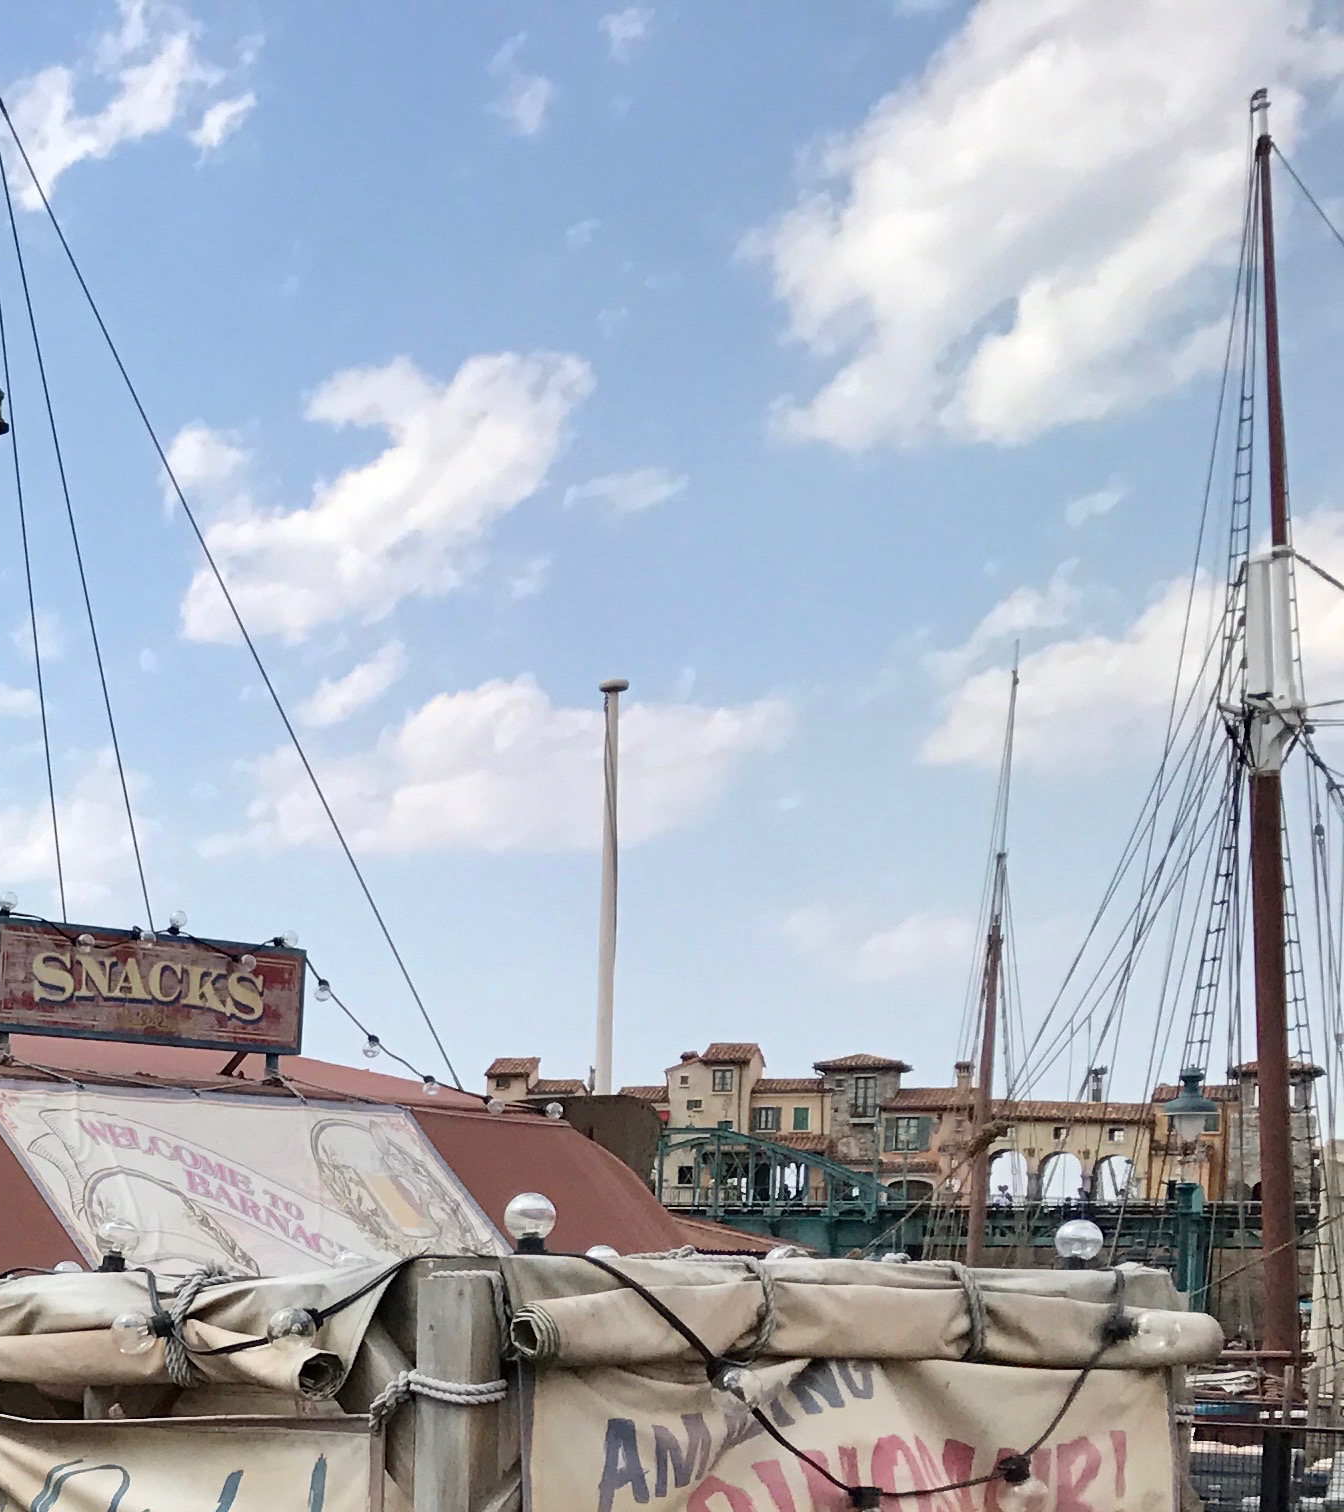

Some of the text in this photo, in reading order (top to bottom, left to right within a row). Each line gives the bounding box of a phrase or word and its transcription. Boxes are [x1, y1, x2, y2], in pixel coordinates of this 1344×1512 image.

[33, 952, 264, 1024] SNACKS
[74, 1118, 305, 1221] WELCOME TO
[183, 1167, 346, 1258] BARNAC
